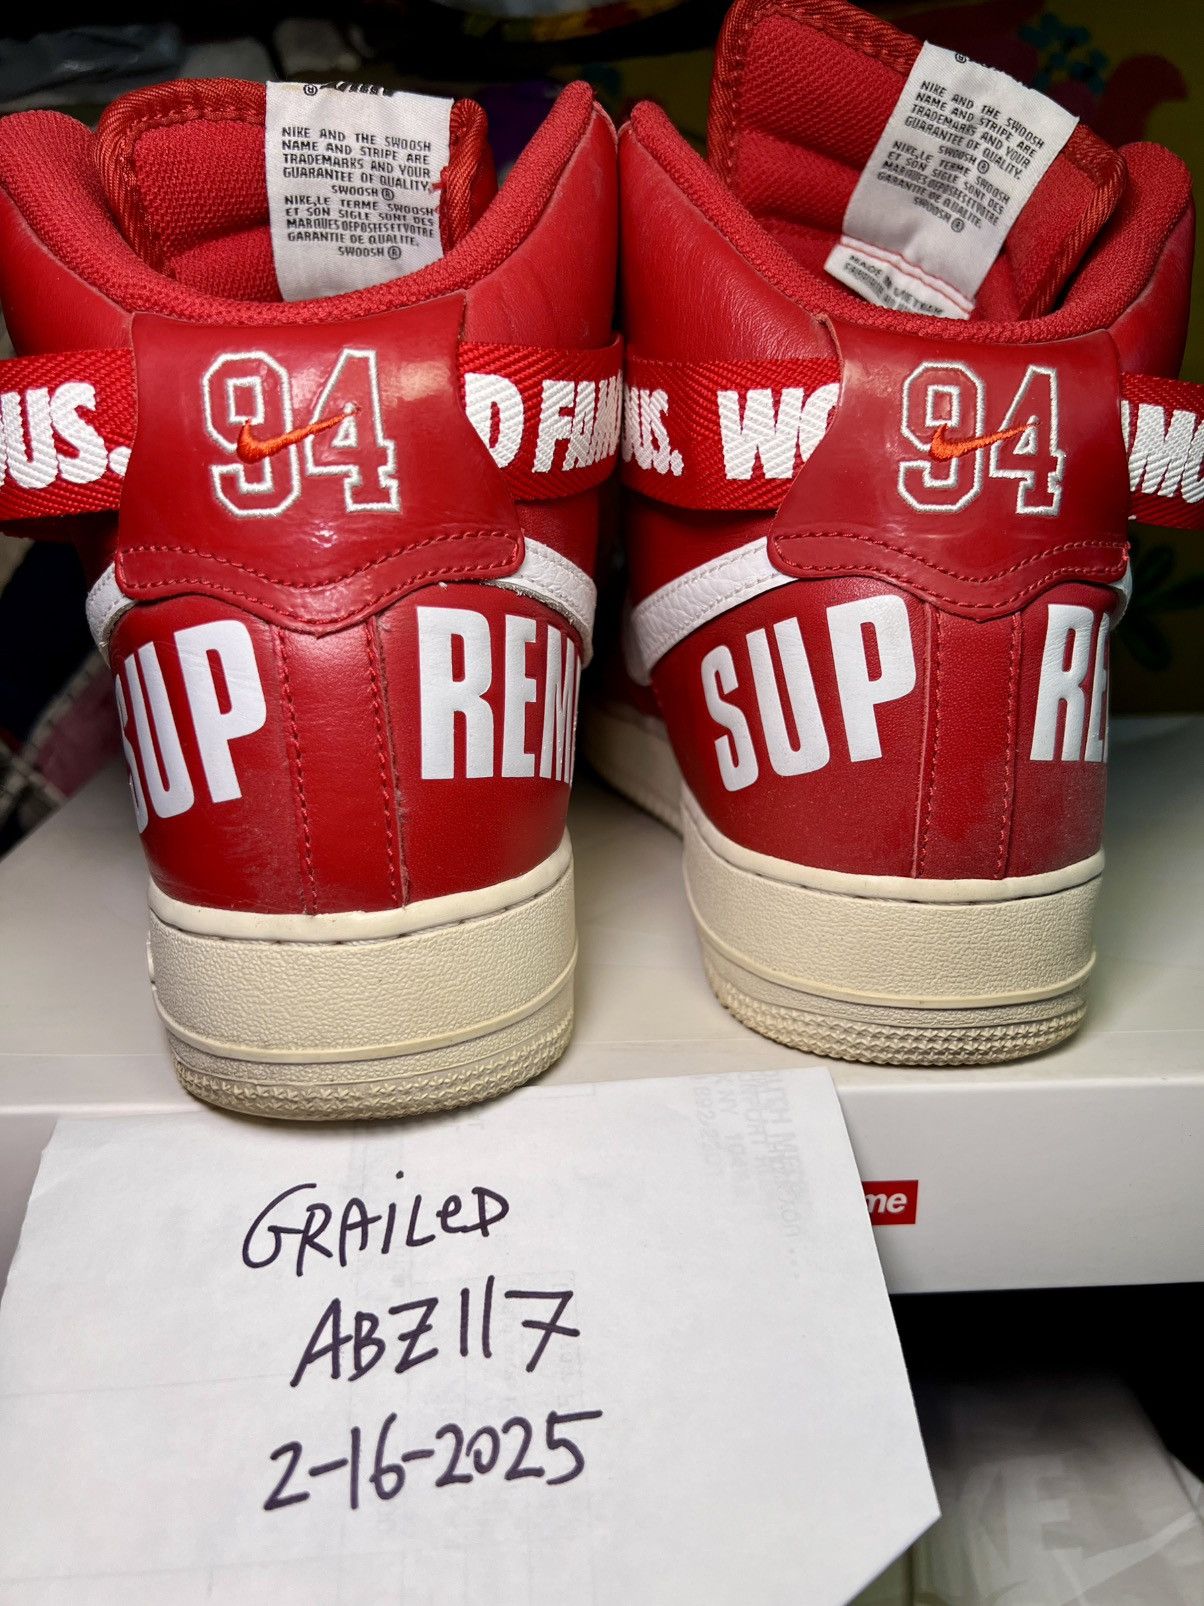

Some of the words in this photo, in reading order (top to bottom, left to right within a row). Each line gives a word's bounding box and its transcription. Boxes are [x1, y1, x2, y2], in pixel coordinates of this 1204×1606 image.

[282, 126, 310, 138] NIKE
[320, 128, 346, 141] AND
[355, 132, 376, 145] THE
[385, 136, 431, 152] SWOOSH
[911, 103, 977, 137] TRADEMARKS
[981, 131, 1003, 150] AND
[1005, 146, 1030, 169] YOUR
[916, 92, 948, 111] NAME
[951, 107, 974, 122] AND
[979, 117, 1013, 142] STRIPE
[1017, 141, 1037, 158] ARE
[920, 80, 947, 97] NIKE
[951, 94, 974, 109] AND
[981, 105, 1001, 120] THE
[1005, 117, 1045, 149] SWOOSH
[282, 139, 319, 151] NAME
[326, 143, 352, 155] AND
[360, 146, 399, 161] STRIPE
[406, 153, 430, 165] ARE
[282, 153, 364, 169] TRADEMARKS
[371, 160, 394, 173] AND
[399, 164, 430, 178] YOUR
[283, 166, 353, 182] GUARANTEE
[361, 172, 374, 184] OF
[887, 151, 901, 161] ET
[905, 157, 927, 172] SON
[931, 168, 959, 183] SIGLE
[963, 181, 985, 201] SONT
[904, 115, 965, 146] GUARANTEE
[966, 139, 980, 151] OF
[982, 147, 1022, 180] QUALITY.
[285, 207, 299, 216] ET
[307, 207, 330, 216] SON
[339, 209, 369, 220] SIGLE
[379, 213, 407, 221] SONT
[413, 216, 433, 226] DES
[331, 185, 378, 197] SWOOSH
[340, 199, 378, 210] TERME
[387, 203, 433, 216] SWOOSH
[287, 231, 346, 243] GARANTIE
[350, 234, 364, 244] DE
[338, 246, 384, 257] SWOOSH
[0, 381, 132, 489] US.
[202, 348, 401, 518] 94
[897, 361, 1066, 516] 94
[417, 606, 582, 788] REM
[700, 594, 917, 793] SUP
[263, 1410, 603, 1511] 2-16-2025
